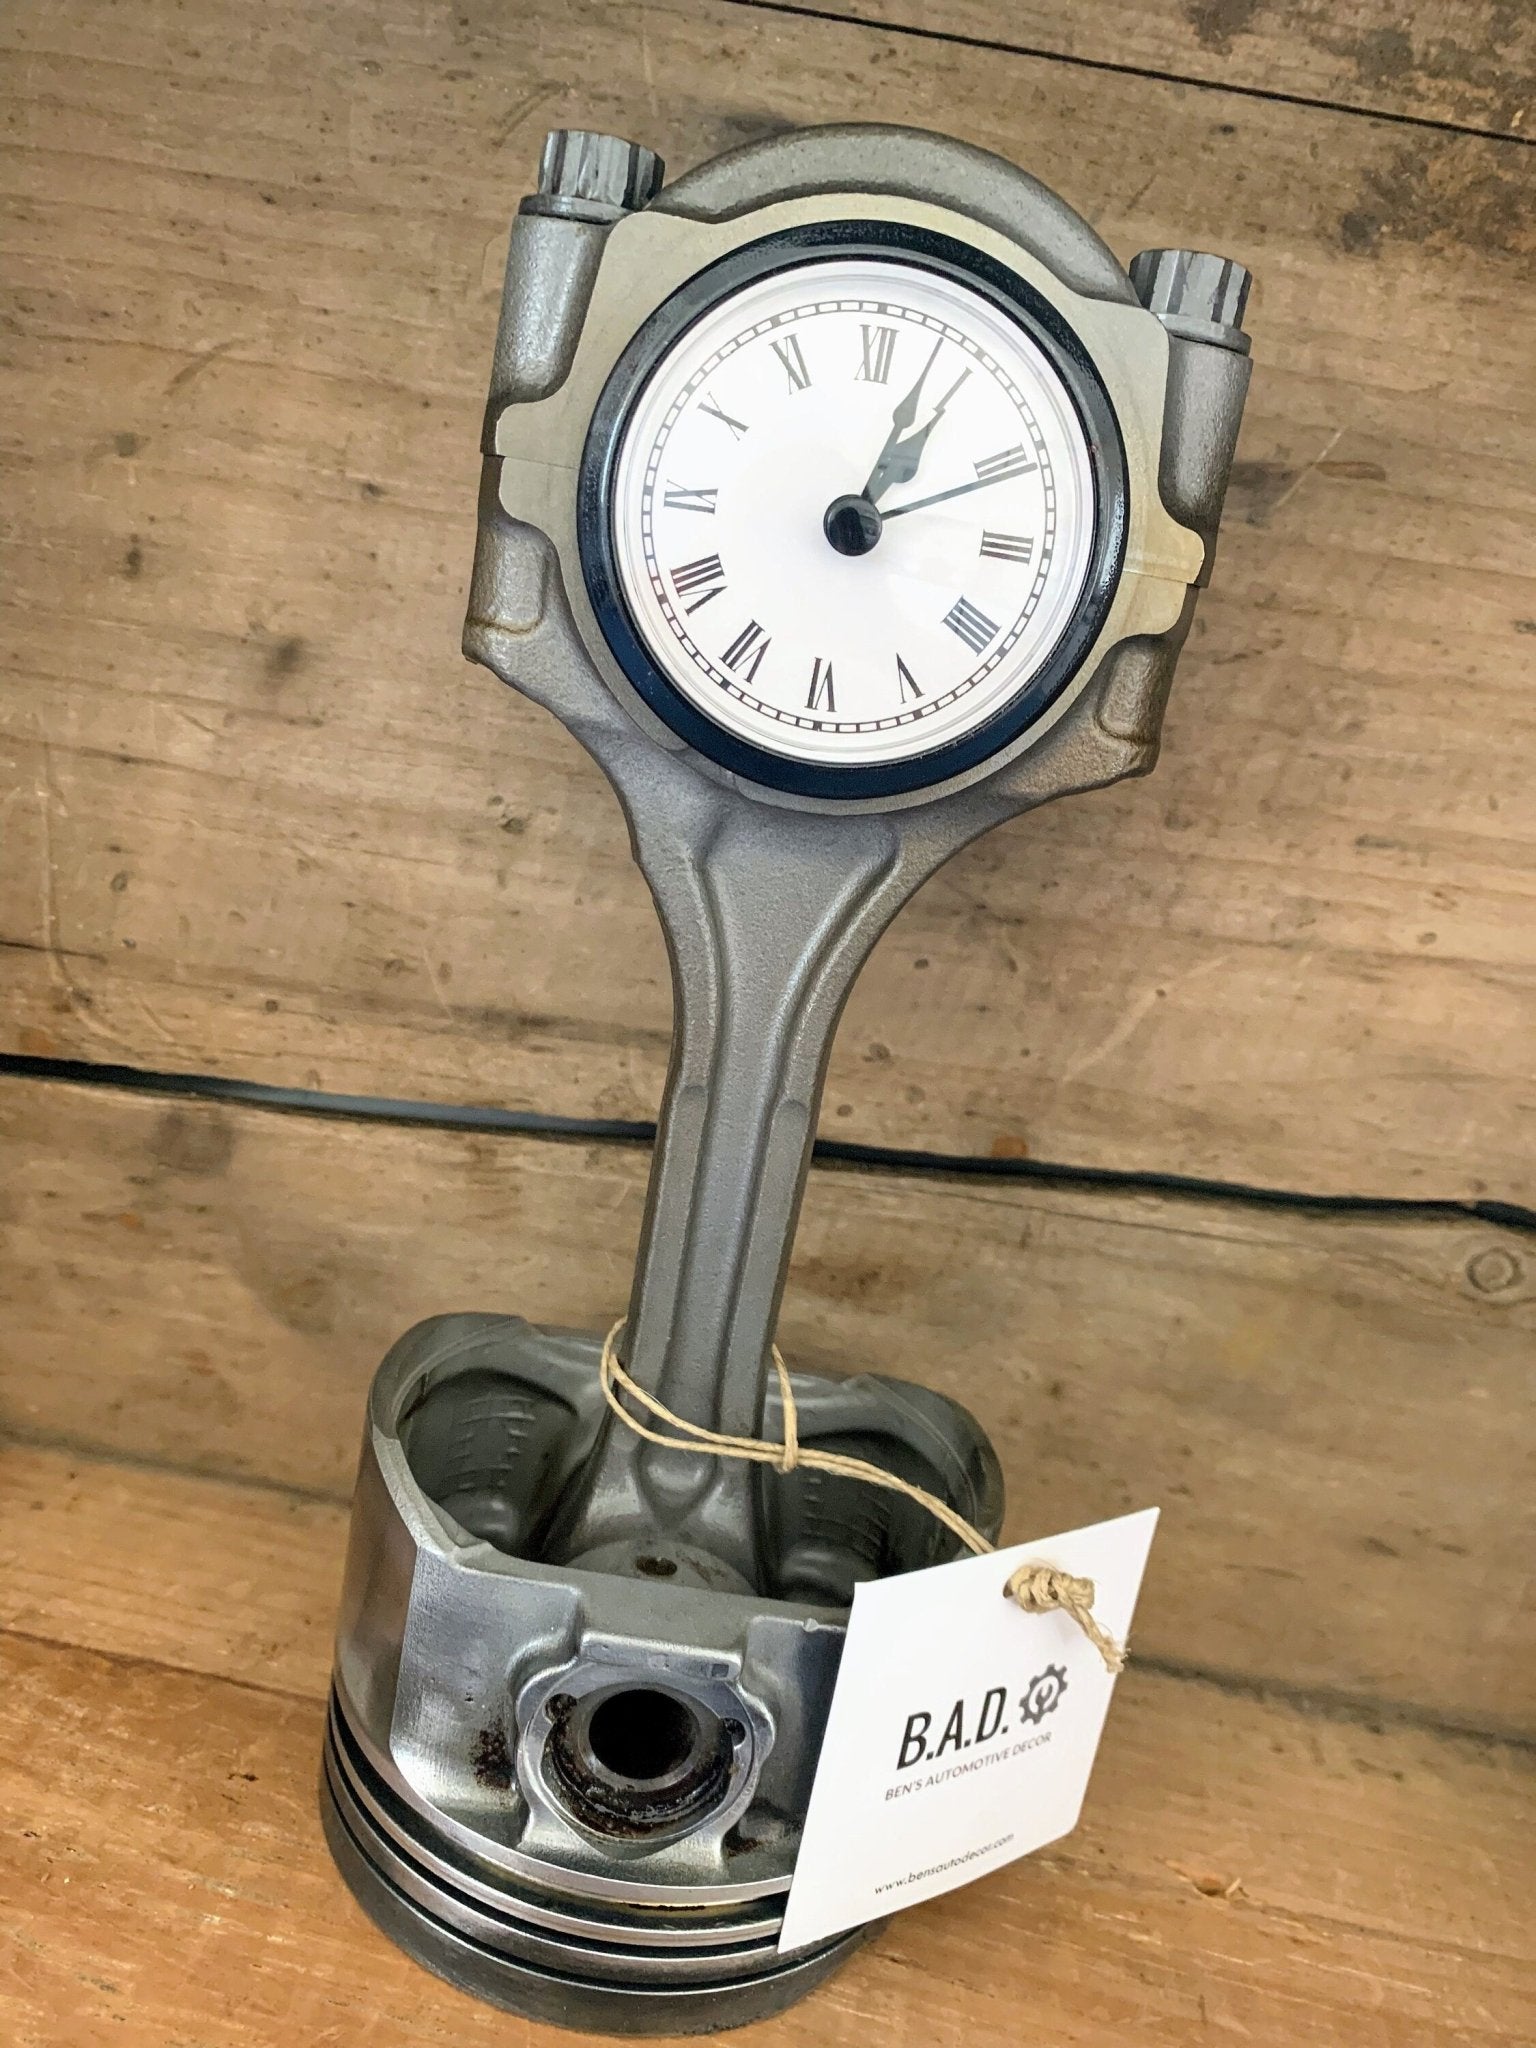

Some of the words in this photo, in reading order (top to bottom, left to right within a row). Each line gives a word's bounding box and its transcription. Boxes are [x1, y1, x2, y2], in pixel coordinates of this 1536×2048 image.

[769, 333, 812, 395] XI
[854, 324, 900, 385] XII
[697, 391, 750, 441] X
[973, 442, 1027, 480] II
[663, 479, 719, 515] IX
[979, 528, 1034, 565] III
[670, 552, 728, 616] VIII
[718, 619, 772, 684] VII
[940, 595, 1001, 657] IIII
[804, 656, 838, 712] VI
[896, 652, 925, 704] V
[896, 1686, 1009, 1770] B.A.D.
[884, 1779, 923, 1801] BEN'S
[925, 1747, 1011, 1788] AUTOMOTIVE
[1012, 1731, 1053, 1757] DECOR
[874, 1833, 1015, 1895] www.bensautodecor.com
